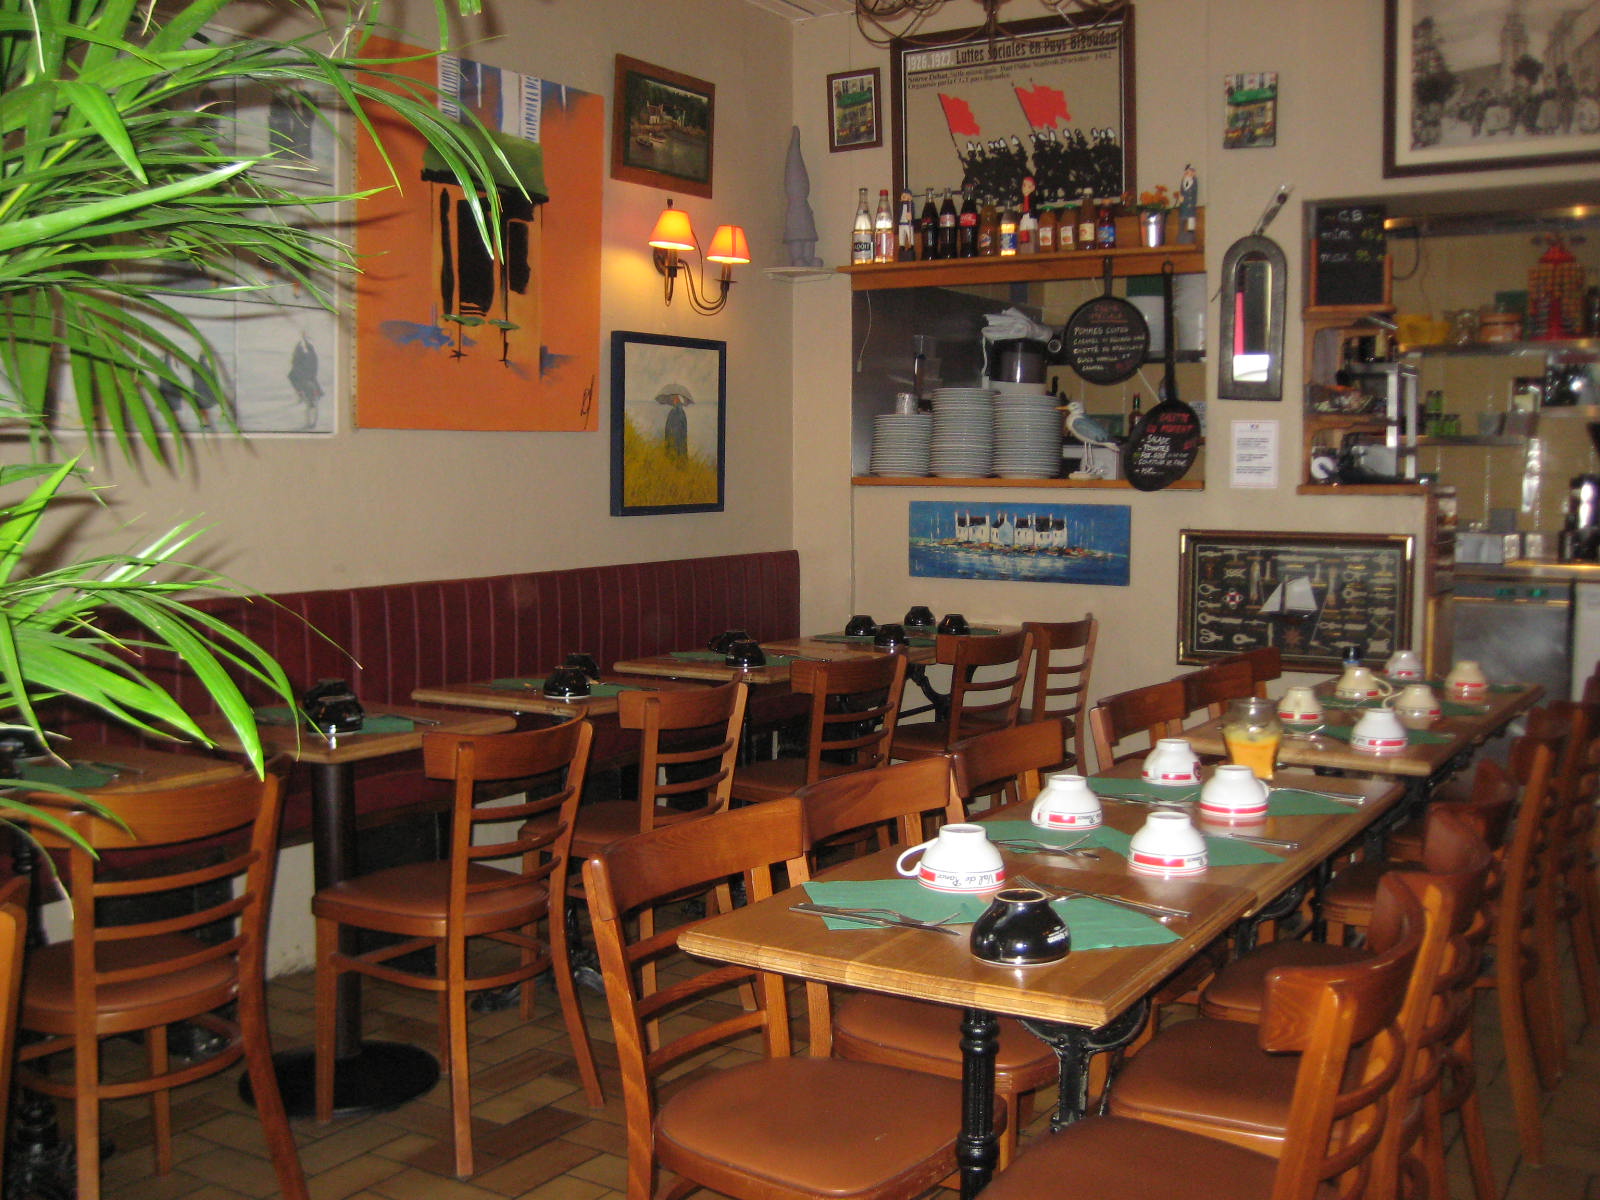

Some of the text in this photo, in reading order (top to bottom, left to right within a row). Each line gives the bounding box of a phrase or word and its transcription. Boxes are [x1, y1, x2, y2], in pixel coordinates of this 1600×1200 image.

[956, 47, 984, 65] Luttes
[1029, 41, 1041, 54] en
[1147, 434, 1171, 445] SALADE
[965, 876, 977, 884] de
[978, 873, 994, 886] Val
